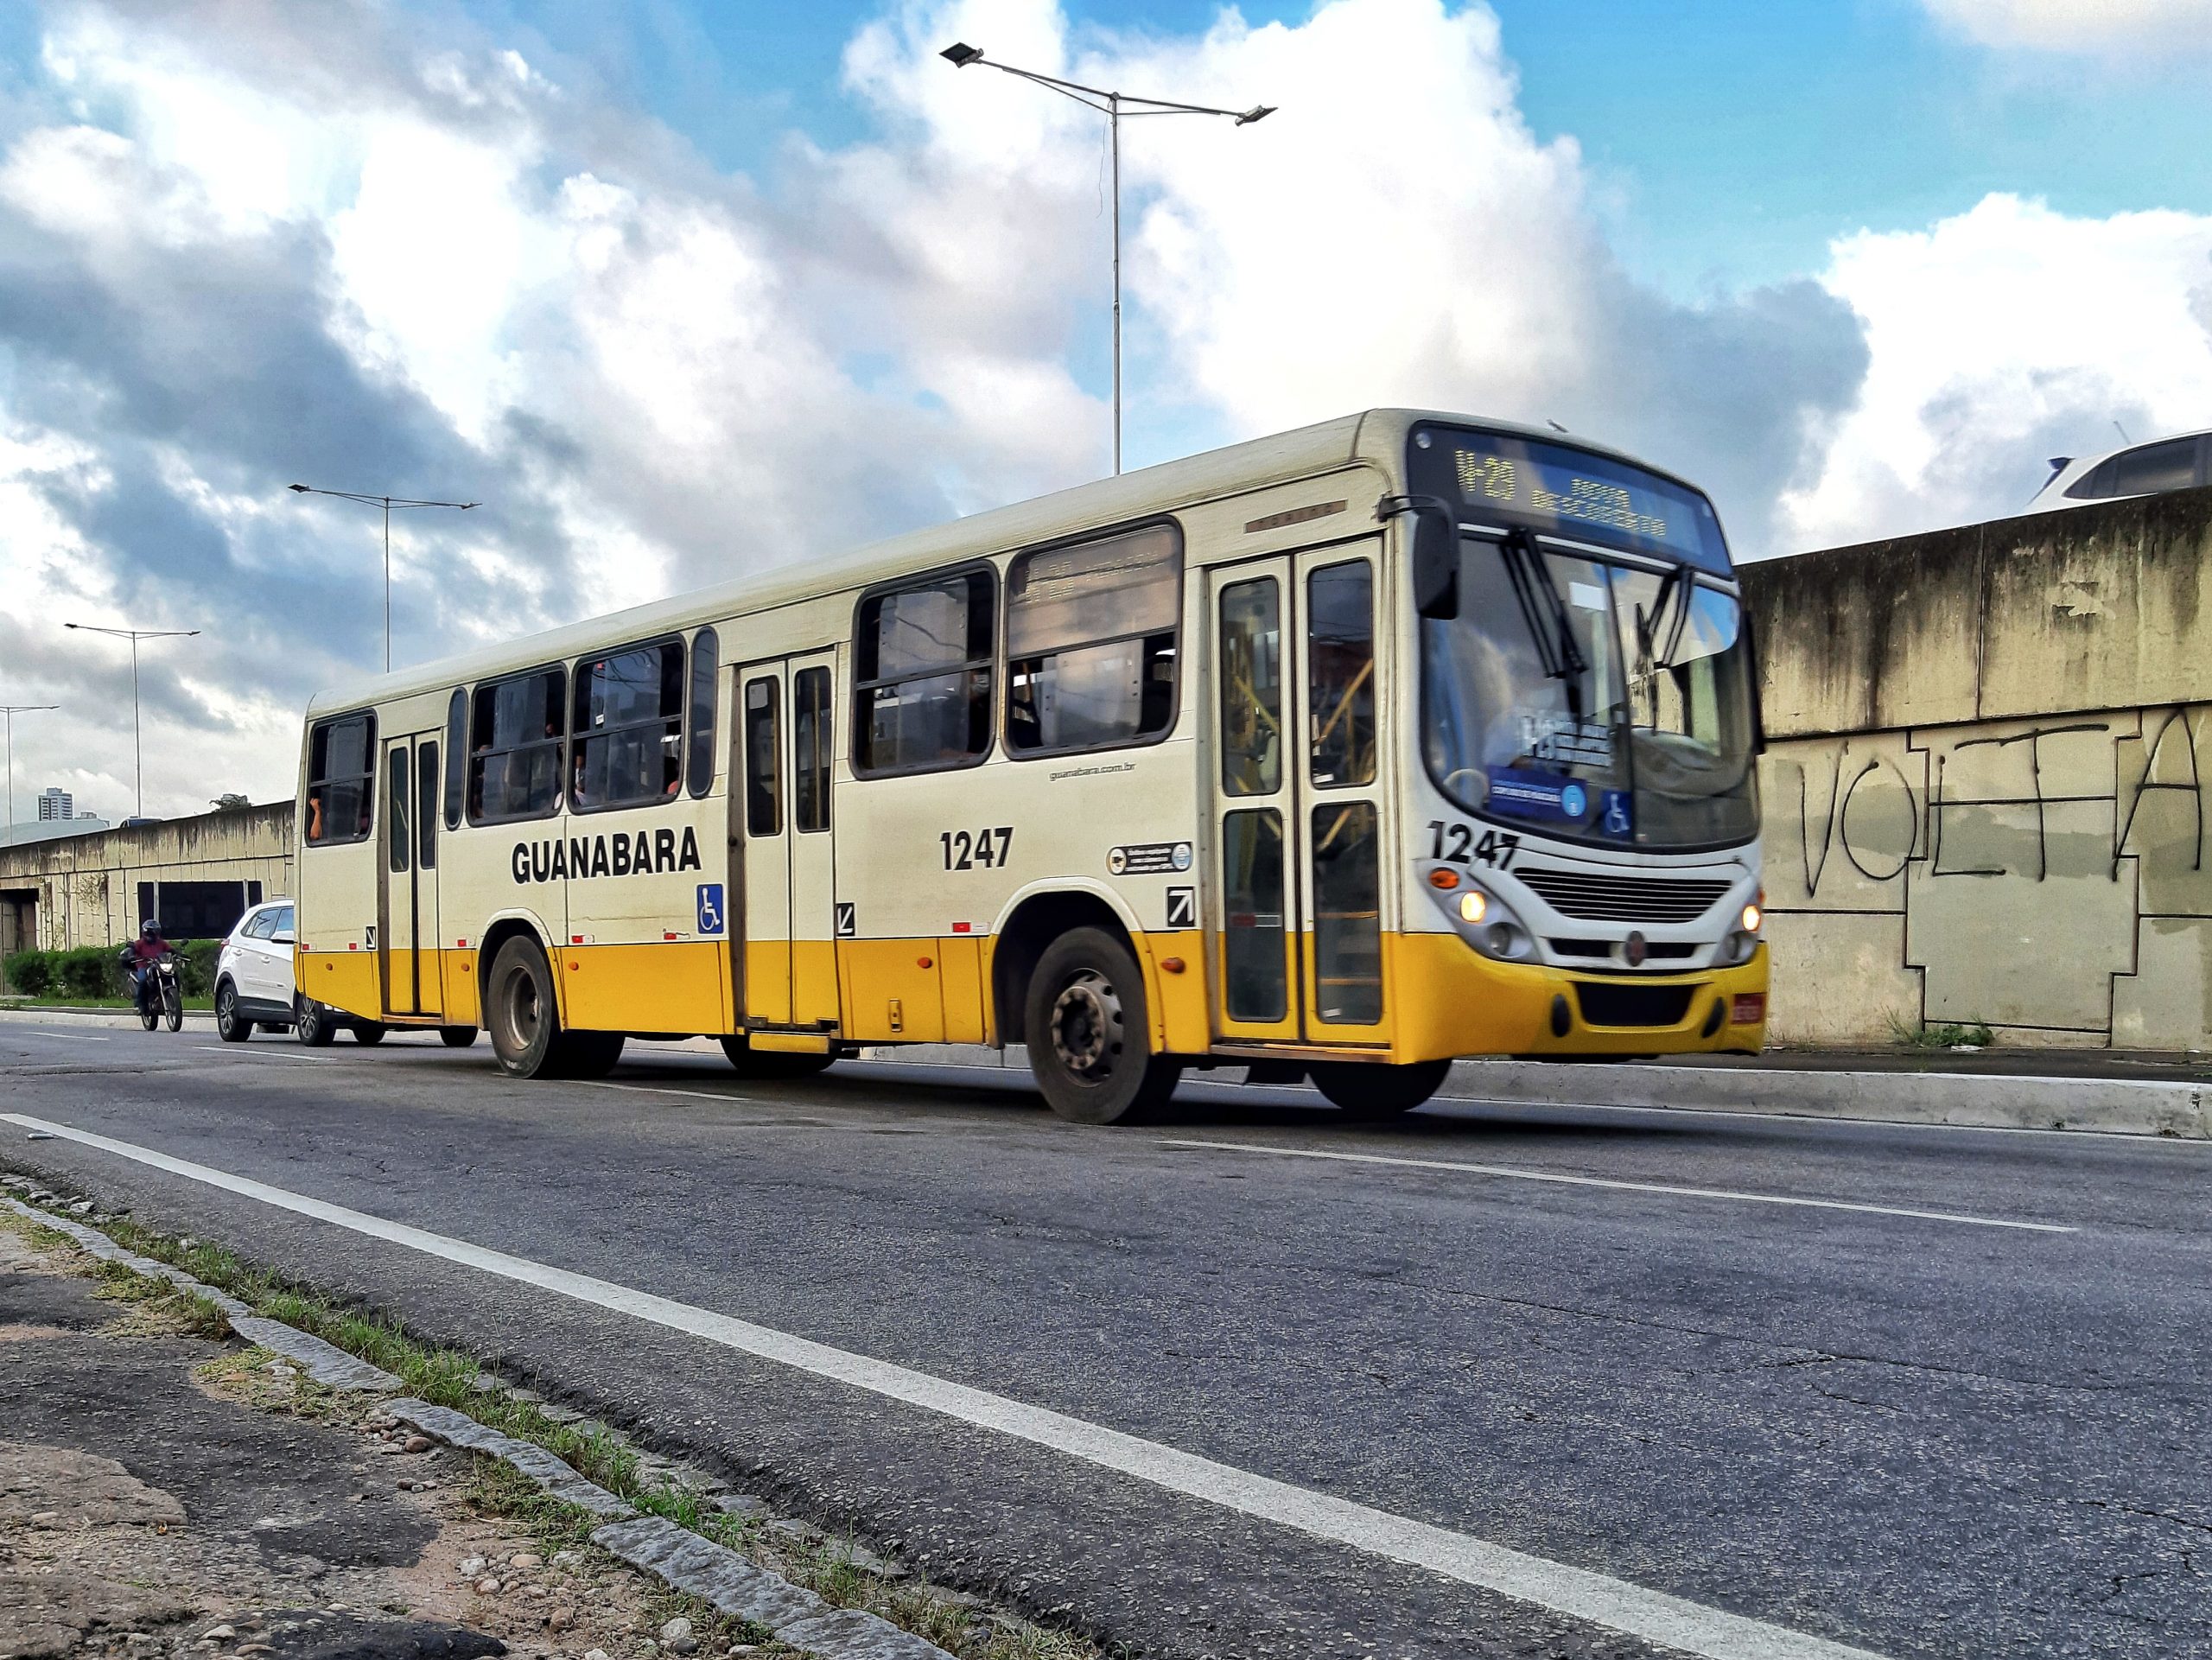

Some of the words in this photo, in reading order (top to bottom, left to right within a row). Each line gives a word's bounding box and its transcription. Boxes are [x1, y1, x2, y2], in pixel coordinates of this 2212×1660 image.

[1798, 707, 2202, 899] VOLTA
[512, 825, 702, 885] GUANABARA
[939, 826, 1014, 871] 1247
[1427, 820, 1521, 871] 1247
